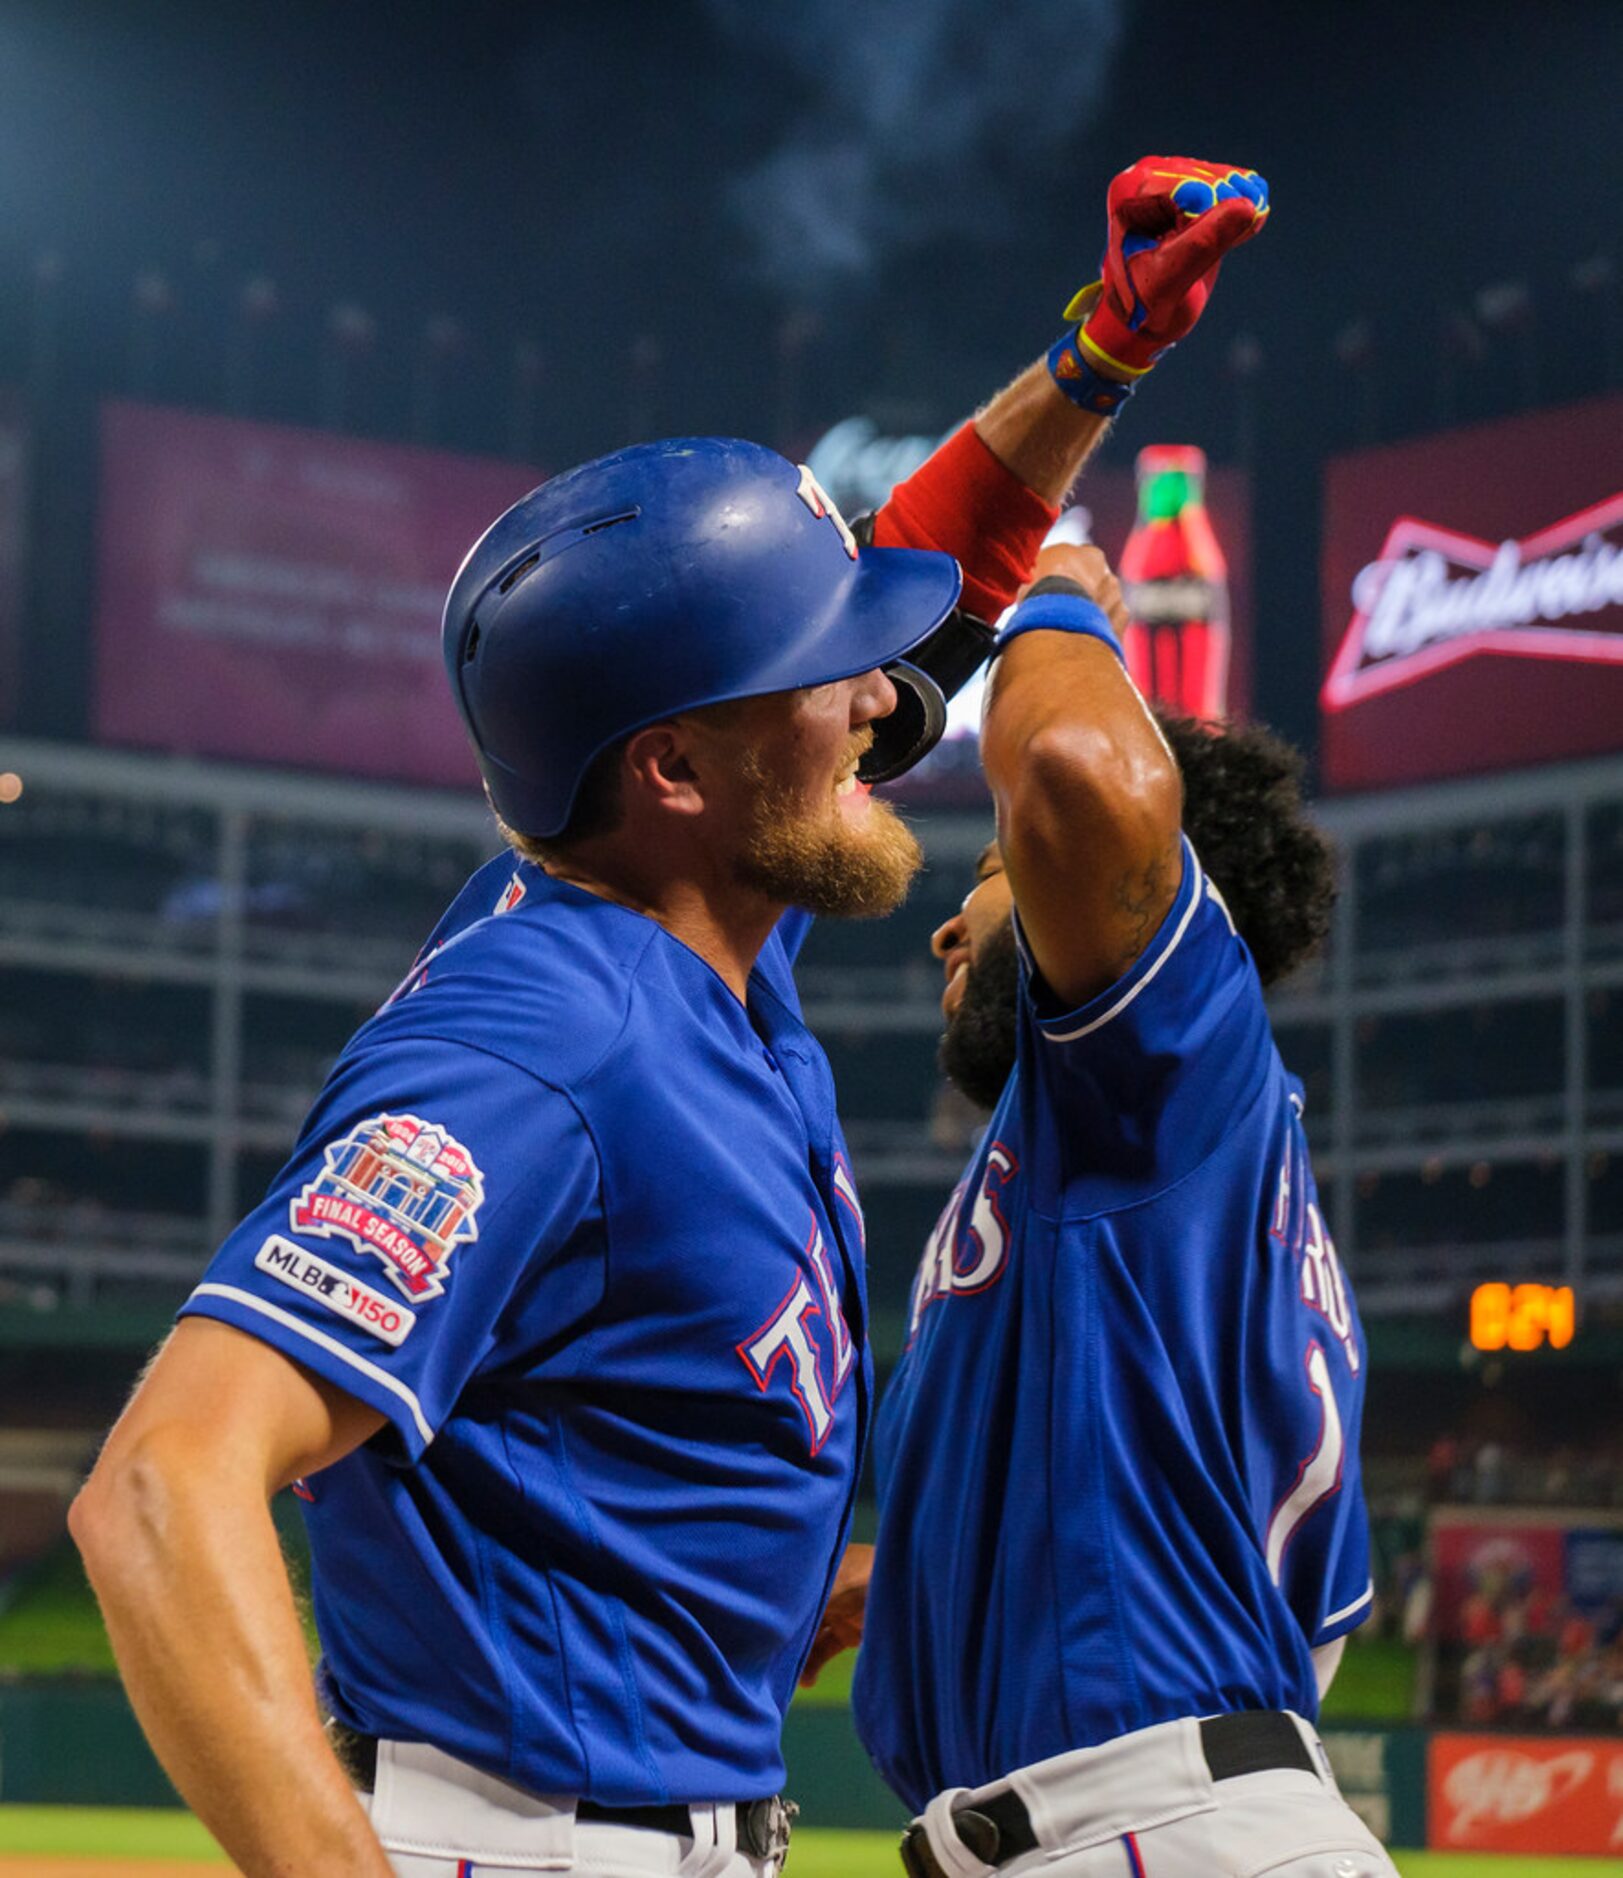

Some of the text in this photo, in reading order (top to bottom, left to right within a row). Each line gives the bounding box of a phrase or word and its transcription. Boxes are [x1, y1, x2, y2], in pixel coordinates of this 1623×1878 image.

[311, 1196, 428, 1278] FINAL SEASON
[266, 1244, 402, 1333] MLB 150
